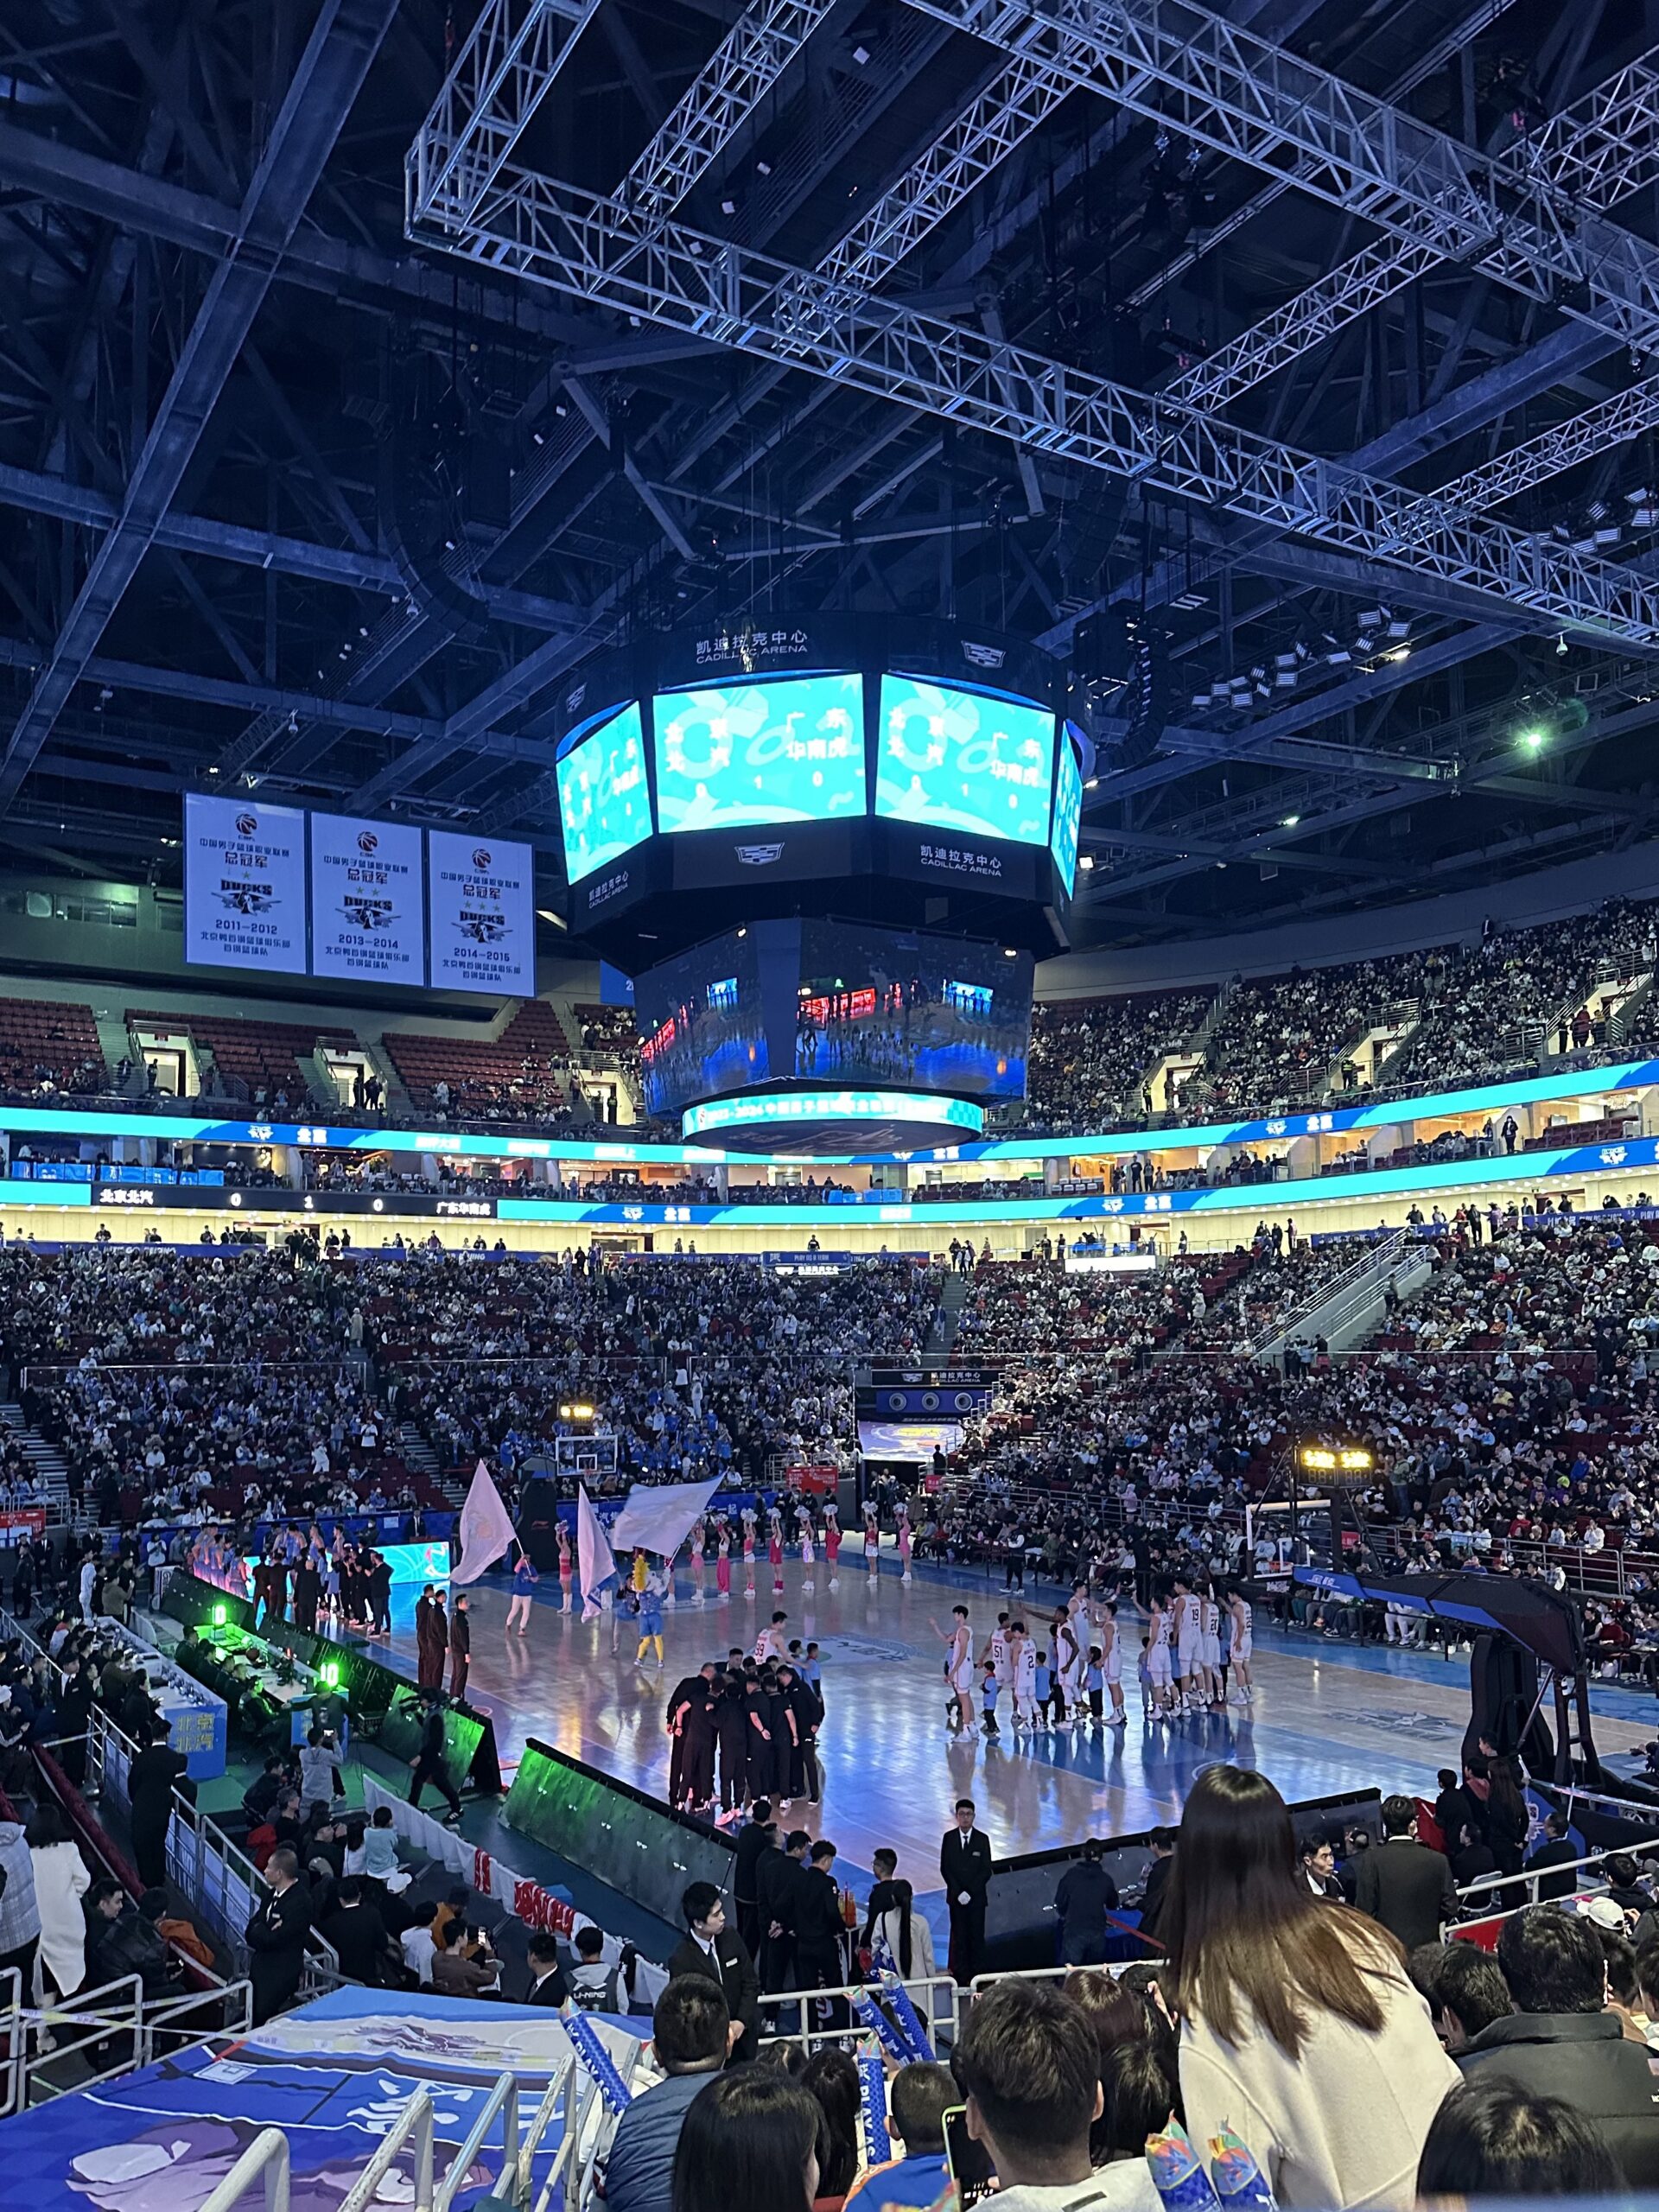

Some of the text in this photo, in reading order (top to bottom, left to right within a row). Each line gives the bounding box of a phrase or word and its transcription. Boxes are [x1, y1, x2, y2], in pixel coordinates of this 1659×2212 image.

[696, 629, 808, 655] 凯迪拉克中心
[696, 645, 808, 664] CADILLC ARENA
[813, 771, 823, 787] 0
[225, 851, 268, 868] 总冠军
[920, 844, 1002, 869] 凯迪拉克中心
[920, 858, 1002, 877] CADILLAC ARENA
[347, 868, 388, 885] 总冠军
[220, 879, 273, 896] DUCKS
[463, 884, 500, 900] 总冠军
[344, 895, 392, 912] DUCKS
[460, 911, 505, 925] DUCKS
[99, 1189, 154, 1205] 北京北汽
[231, 1192, 242, 1207] 0
[373, 1198, 384, 1212] 0
[436, 1202, 491, 1217] 广东华南虎
[994, 1645, 1002, 1658] 51
[1027, 1655, 1034, 1669] 2
